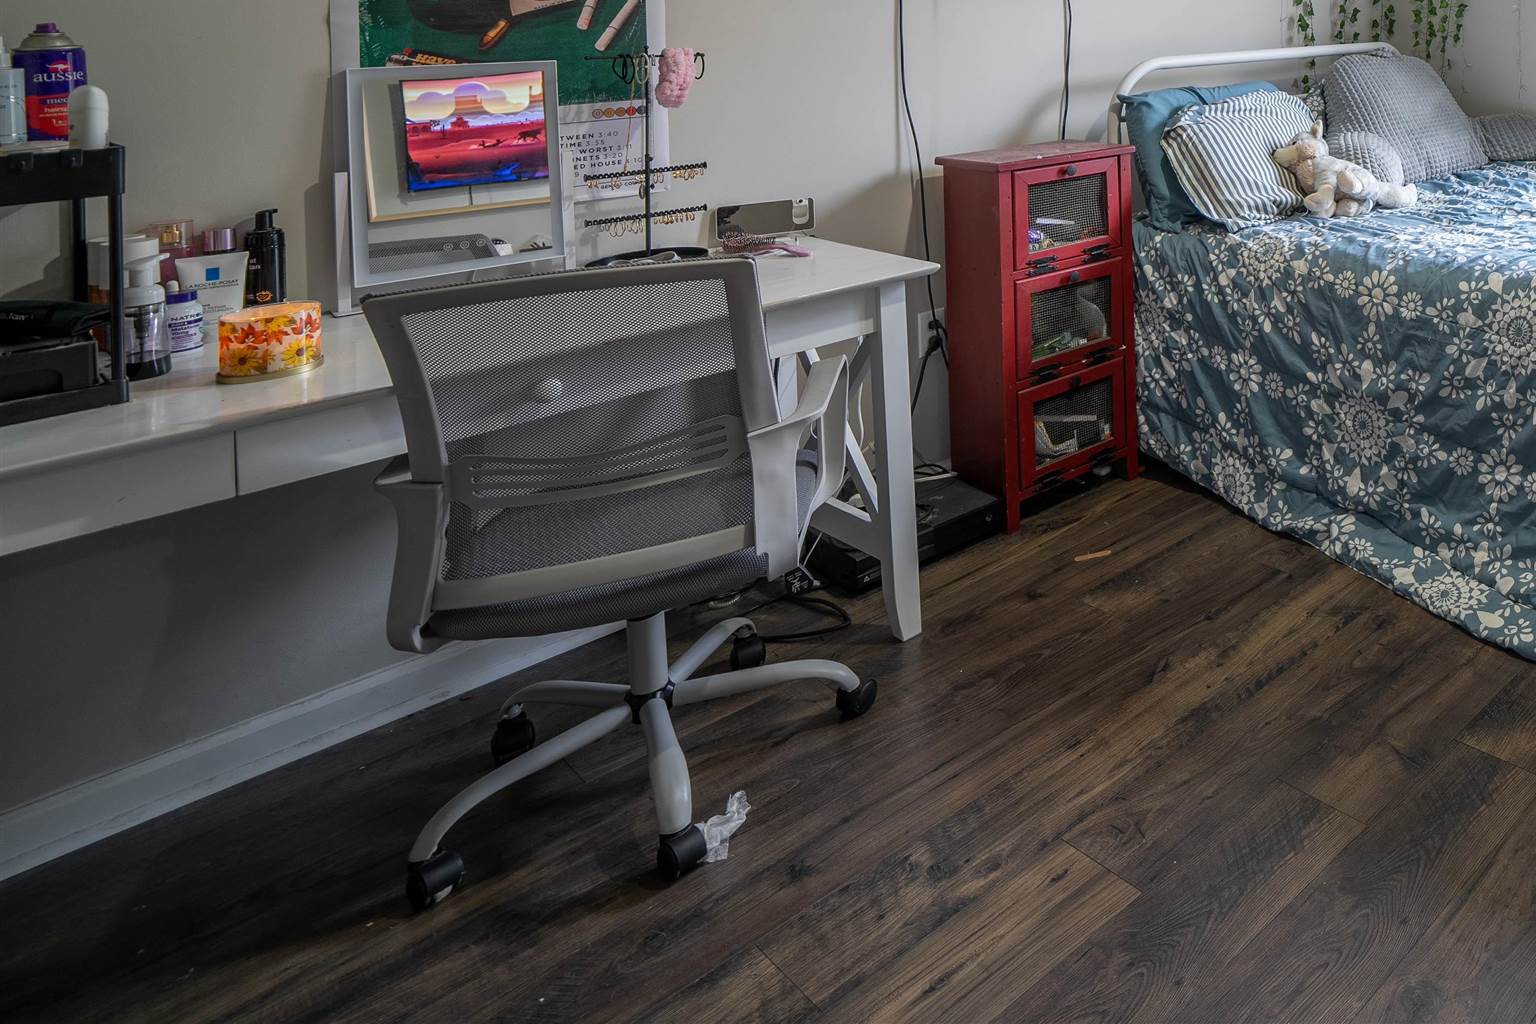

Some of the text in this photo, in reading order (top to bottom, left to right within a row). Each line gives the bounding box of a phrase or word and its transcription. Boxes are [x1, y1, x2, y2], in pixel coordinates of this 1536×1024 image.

[33, 71, 85, 83] aussie
[579, 146, 613, 154] WORST
[590, 160, 622, 168] HOUSE
